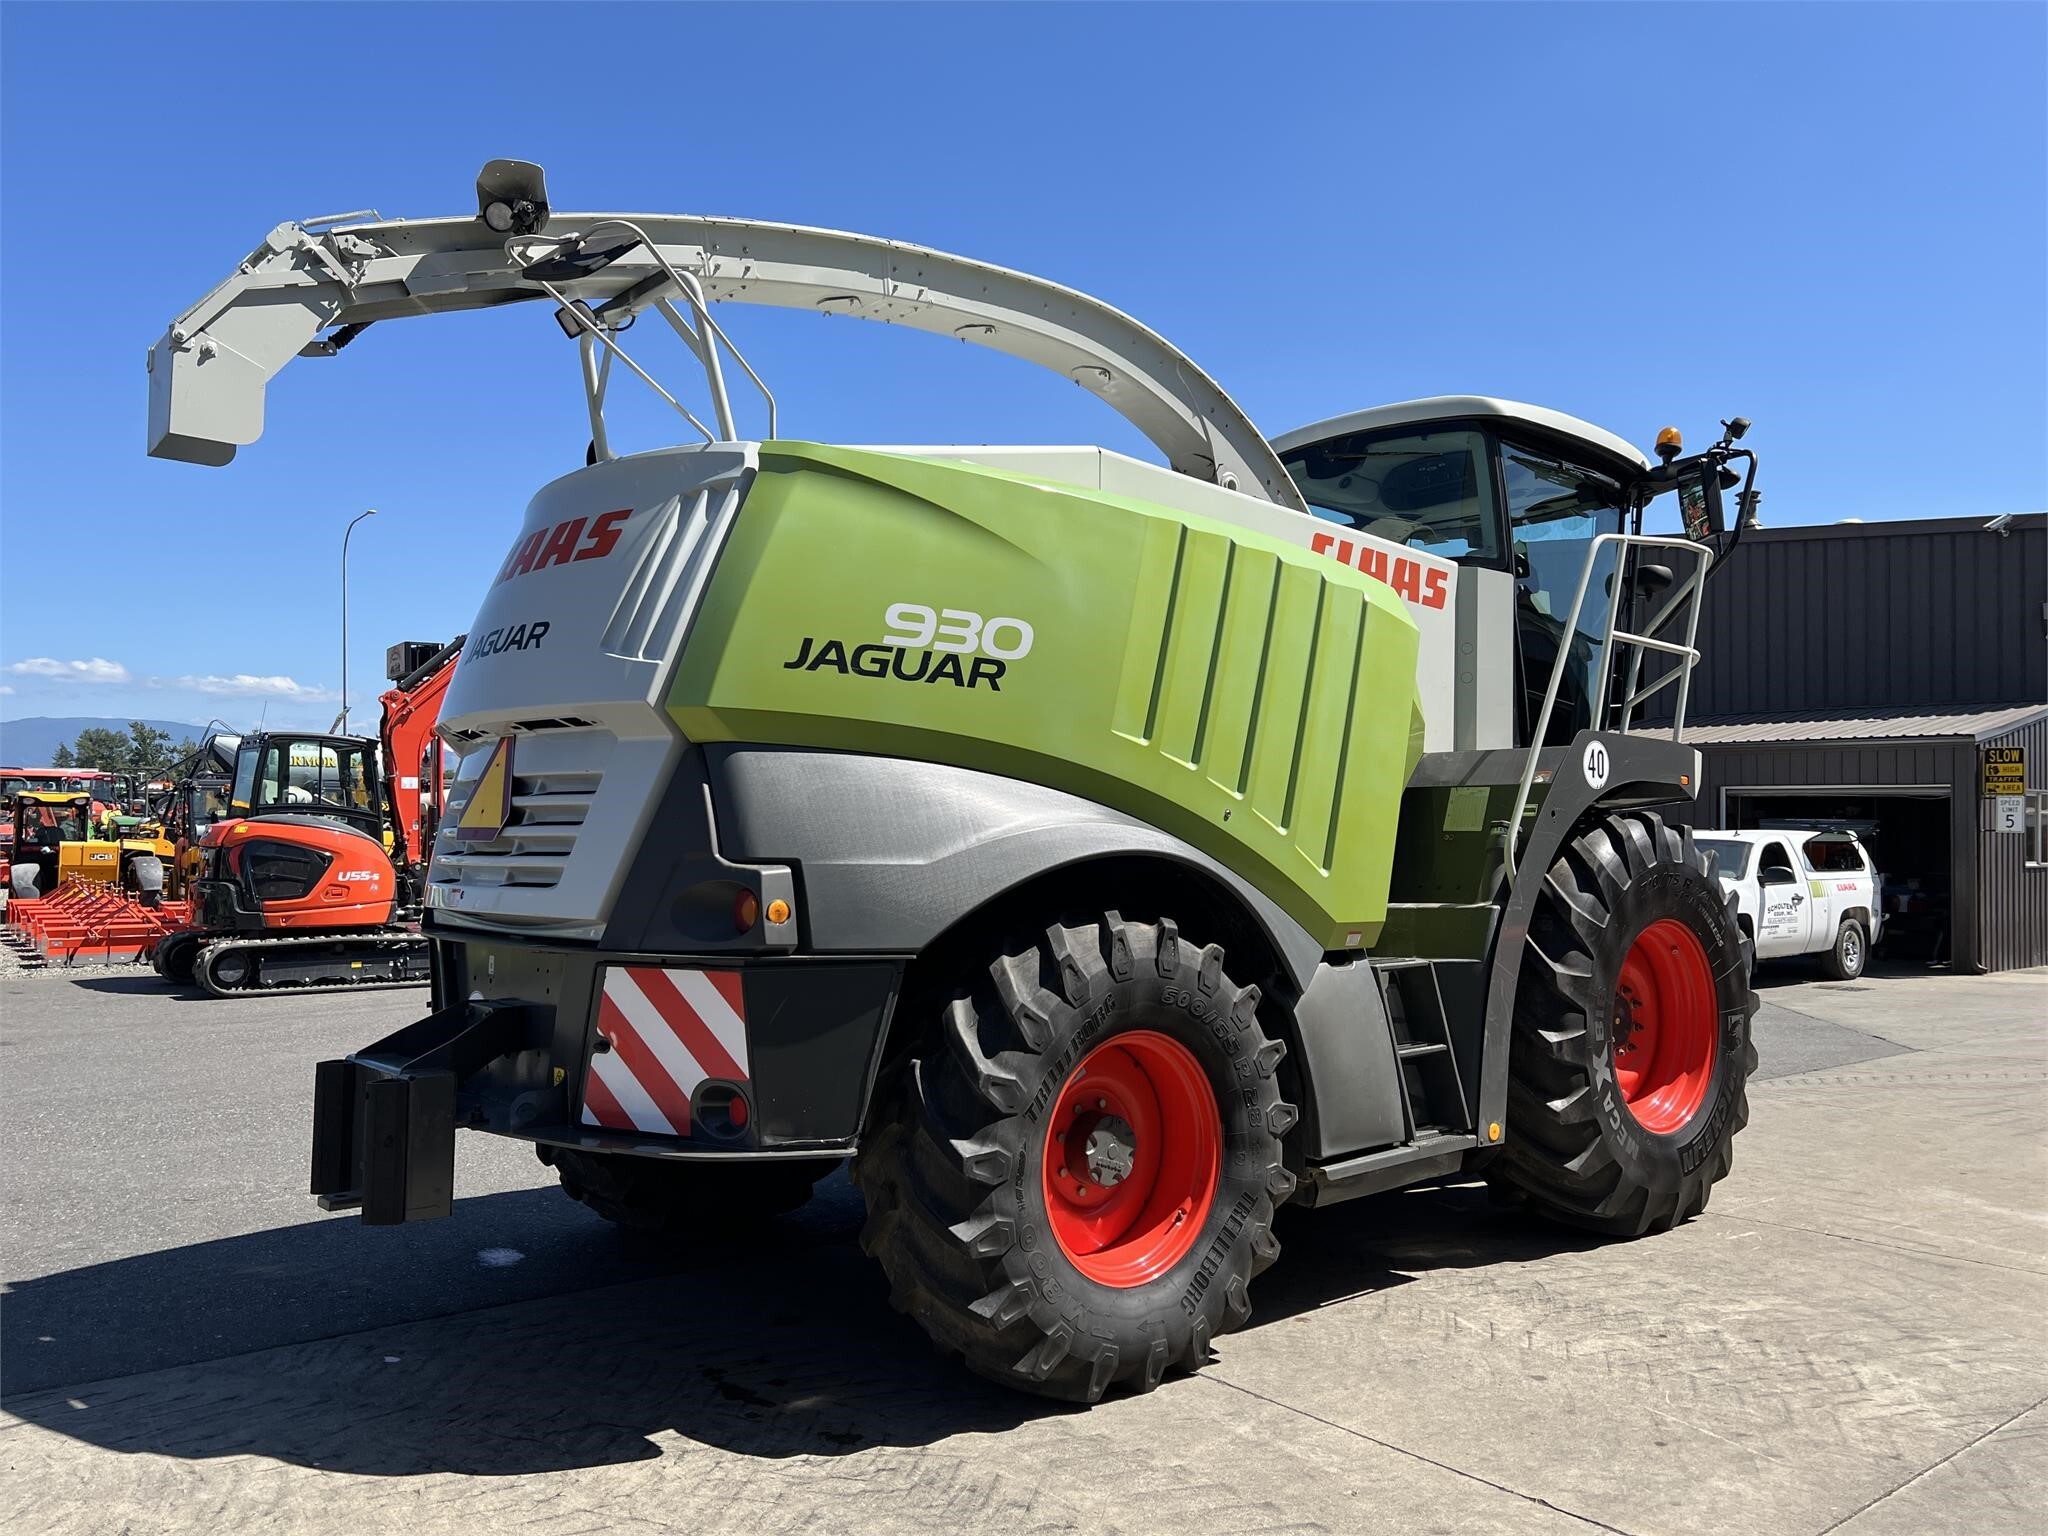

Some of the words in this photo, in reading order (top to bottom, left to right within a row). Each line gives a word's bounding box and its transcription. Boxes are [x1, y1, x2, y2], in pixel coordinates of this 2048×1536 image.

[464, 621, 550, 666] JAGUAR
[883, 603, 1034, 660] 930
[783, 637, 1007, 692] JAGUAR
[1587, 749, 1605, 779] 40
[1989, 750, 2020, 762] SLOW
[2005, 814, 2015, 828] 5
[1180, 1191, 1260, 1317] TRELLEBORG
